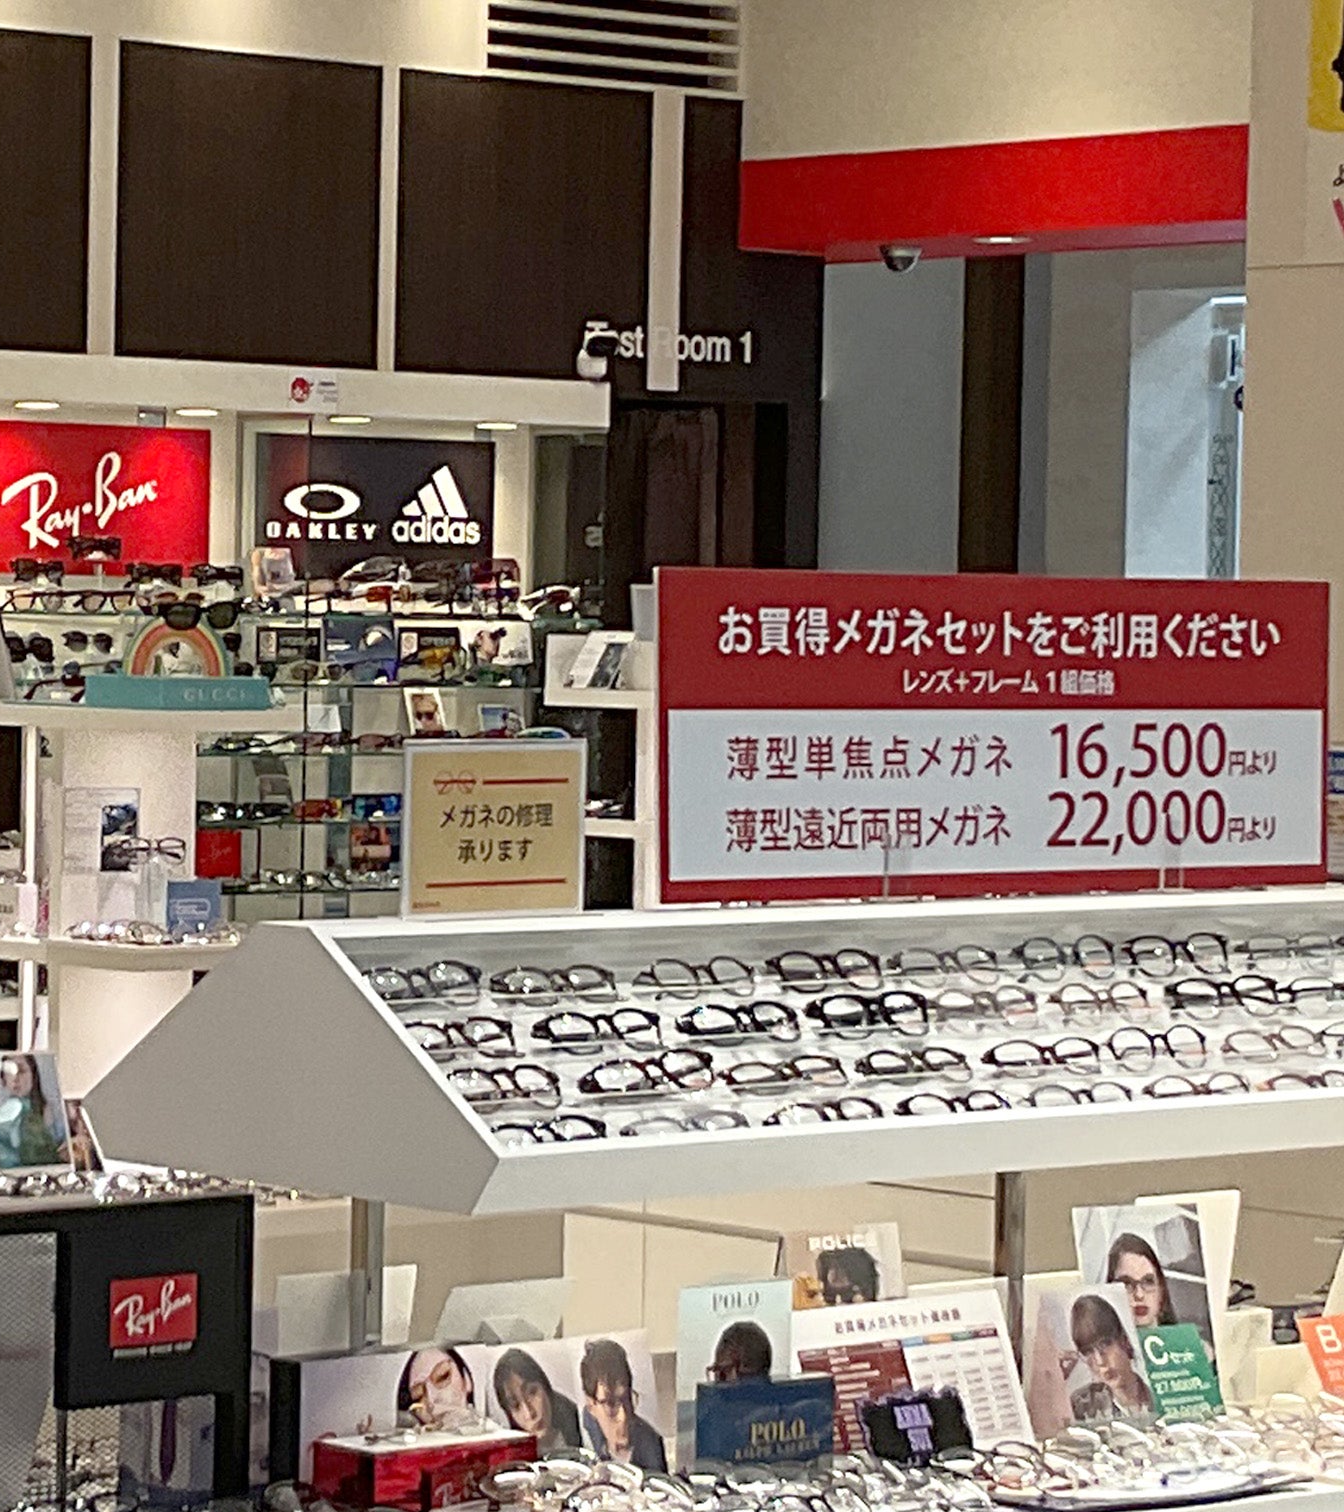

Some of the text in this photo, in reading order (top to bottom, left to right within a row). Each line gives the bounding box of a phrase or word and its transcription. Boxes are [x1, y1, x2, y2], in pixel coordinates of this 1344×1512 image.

[739, 330, 753, 364] 1
[266, 521, 378, 543] OAKLEY
[391, 515, 482, 546] adidas
[717, 605, 1282, 659] お買得メガネセットをご利用ください
[726, 735, 1013, 781] 薄型単焦点メガネ
[439, 802, 554, 829] メガネの修理
[725, 805, 1012, 852] 薄型遠近両用メガネ
[457, 837, 534, 865] 承ります
[712, 1290, 760, 1313] POLO
[750, 1417, 807, 1445] POLO
